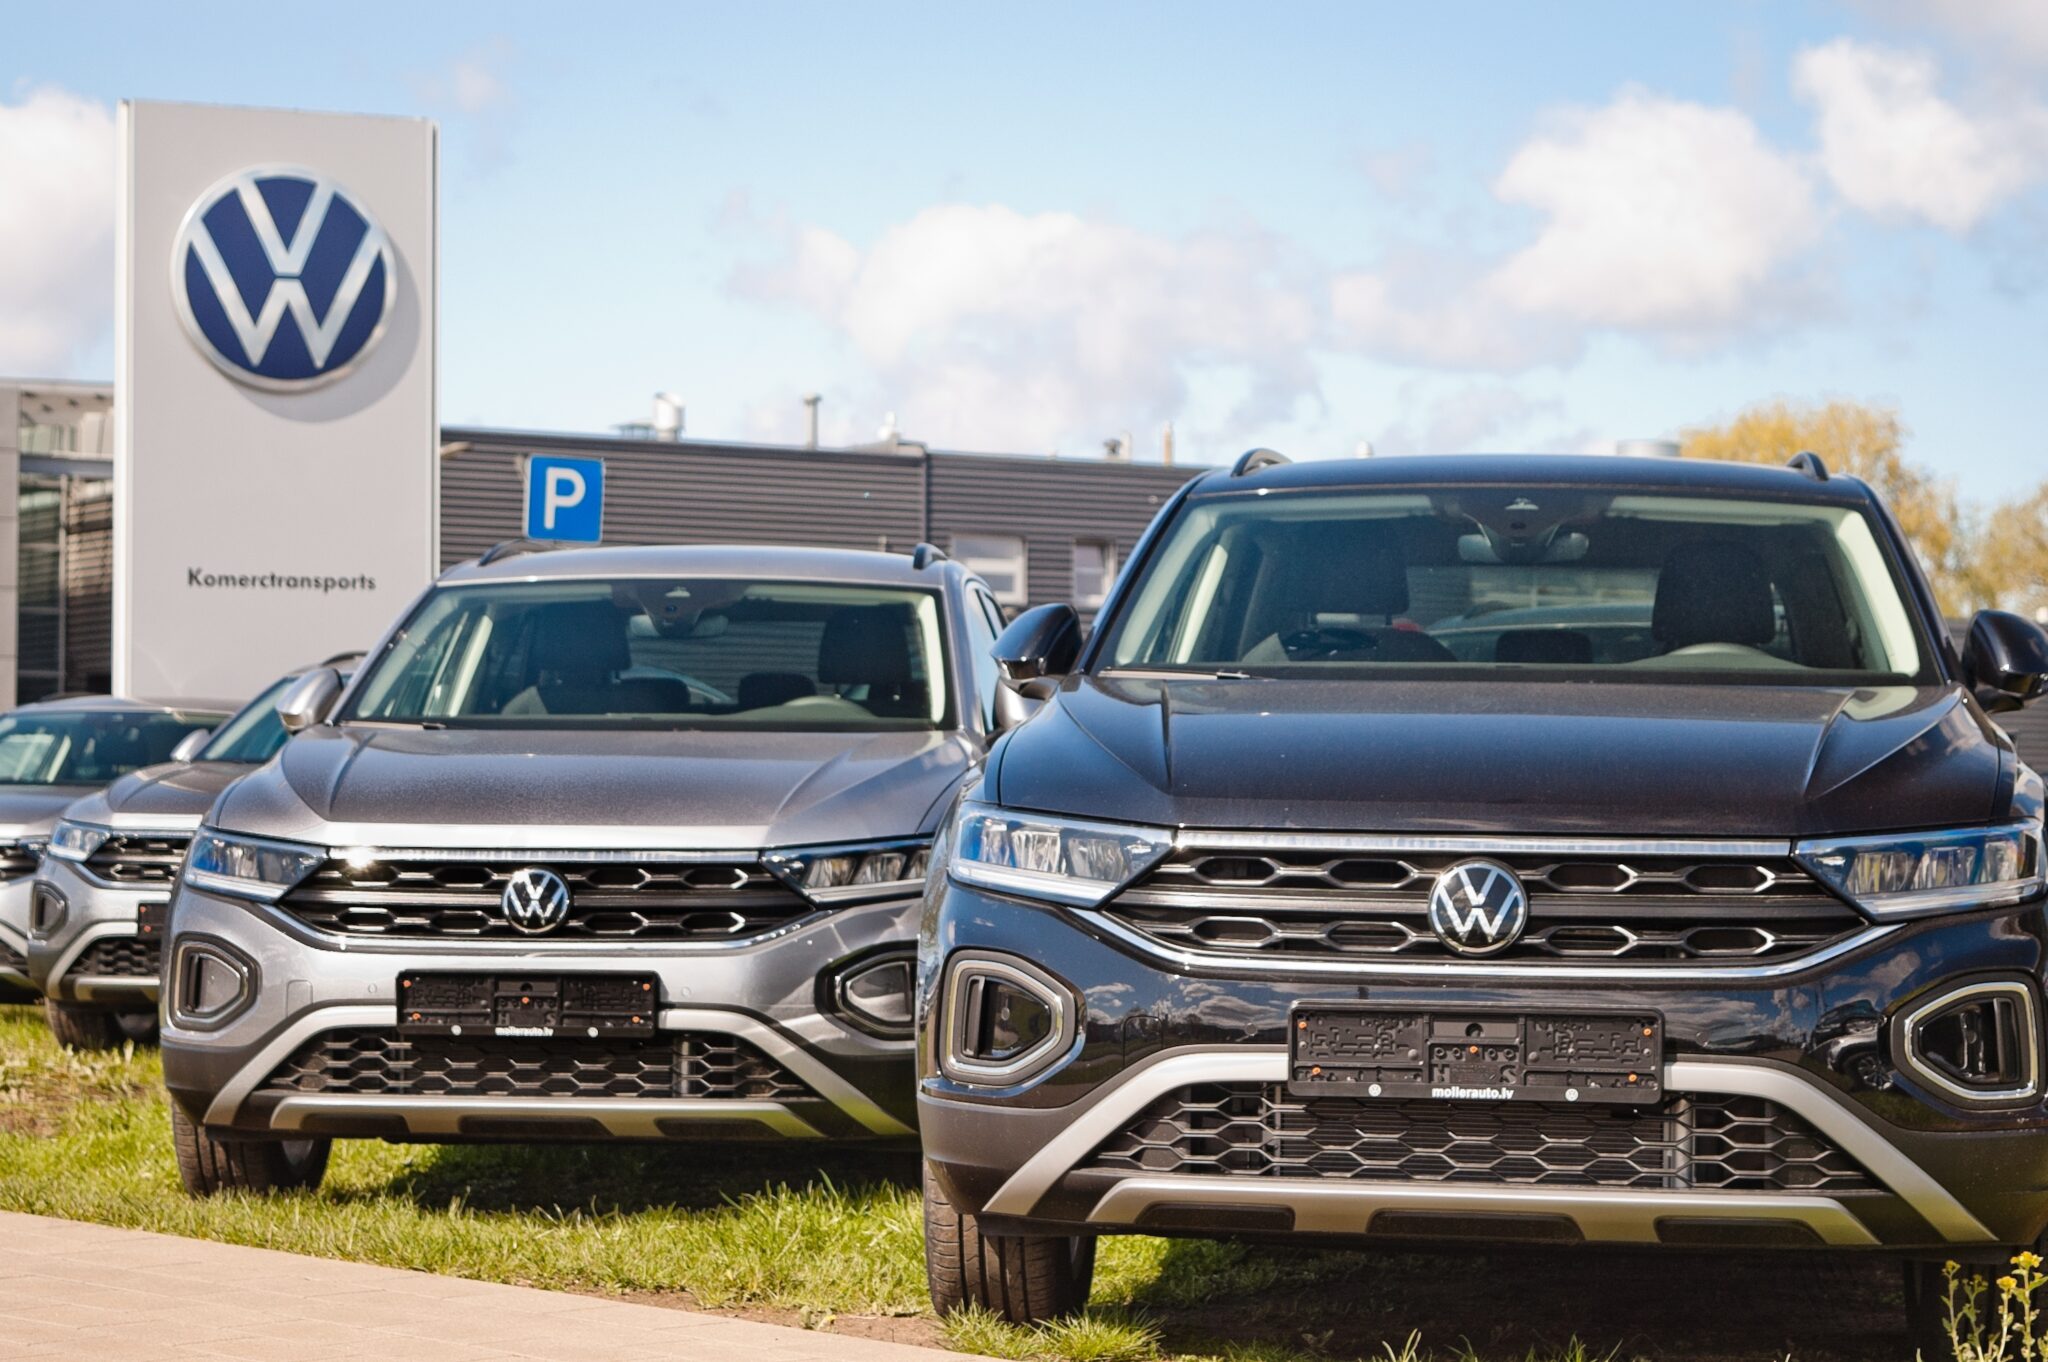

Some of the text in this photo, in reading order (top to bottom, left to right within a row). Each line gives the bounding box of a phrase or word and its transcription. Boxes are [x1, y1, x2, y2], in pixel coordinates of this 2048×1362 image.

[544, 467, 586, 530] P
[188, 567, 376, 593] Komerctransports
[1431, 1086, 1515, 1100] mollerauto.lv
